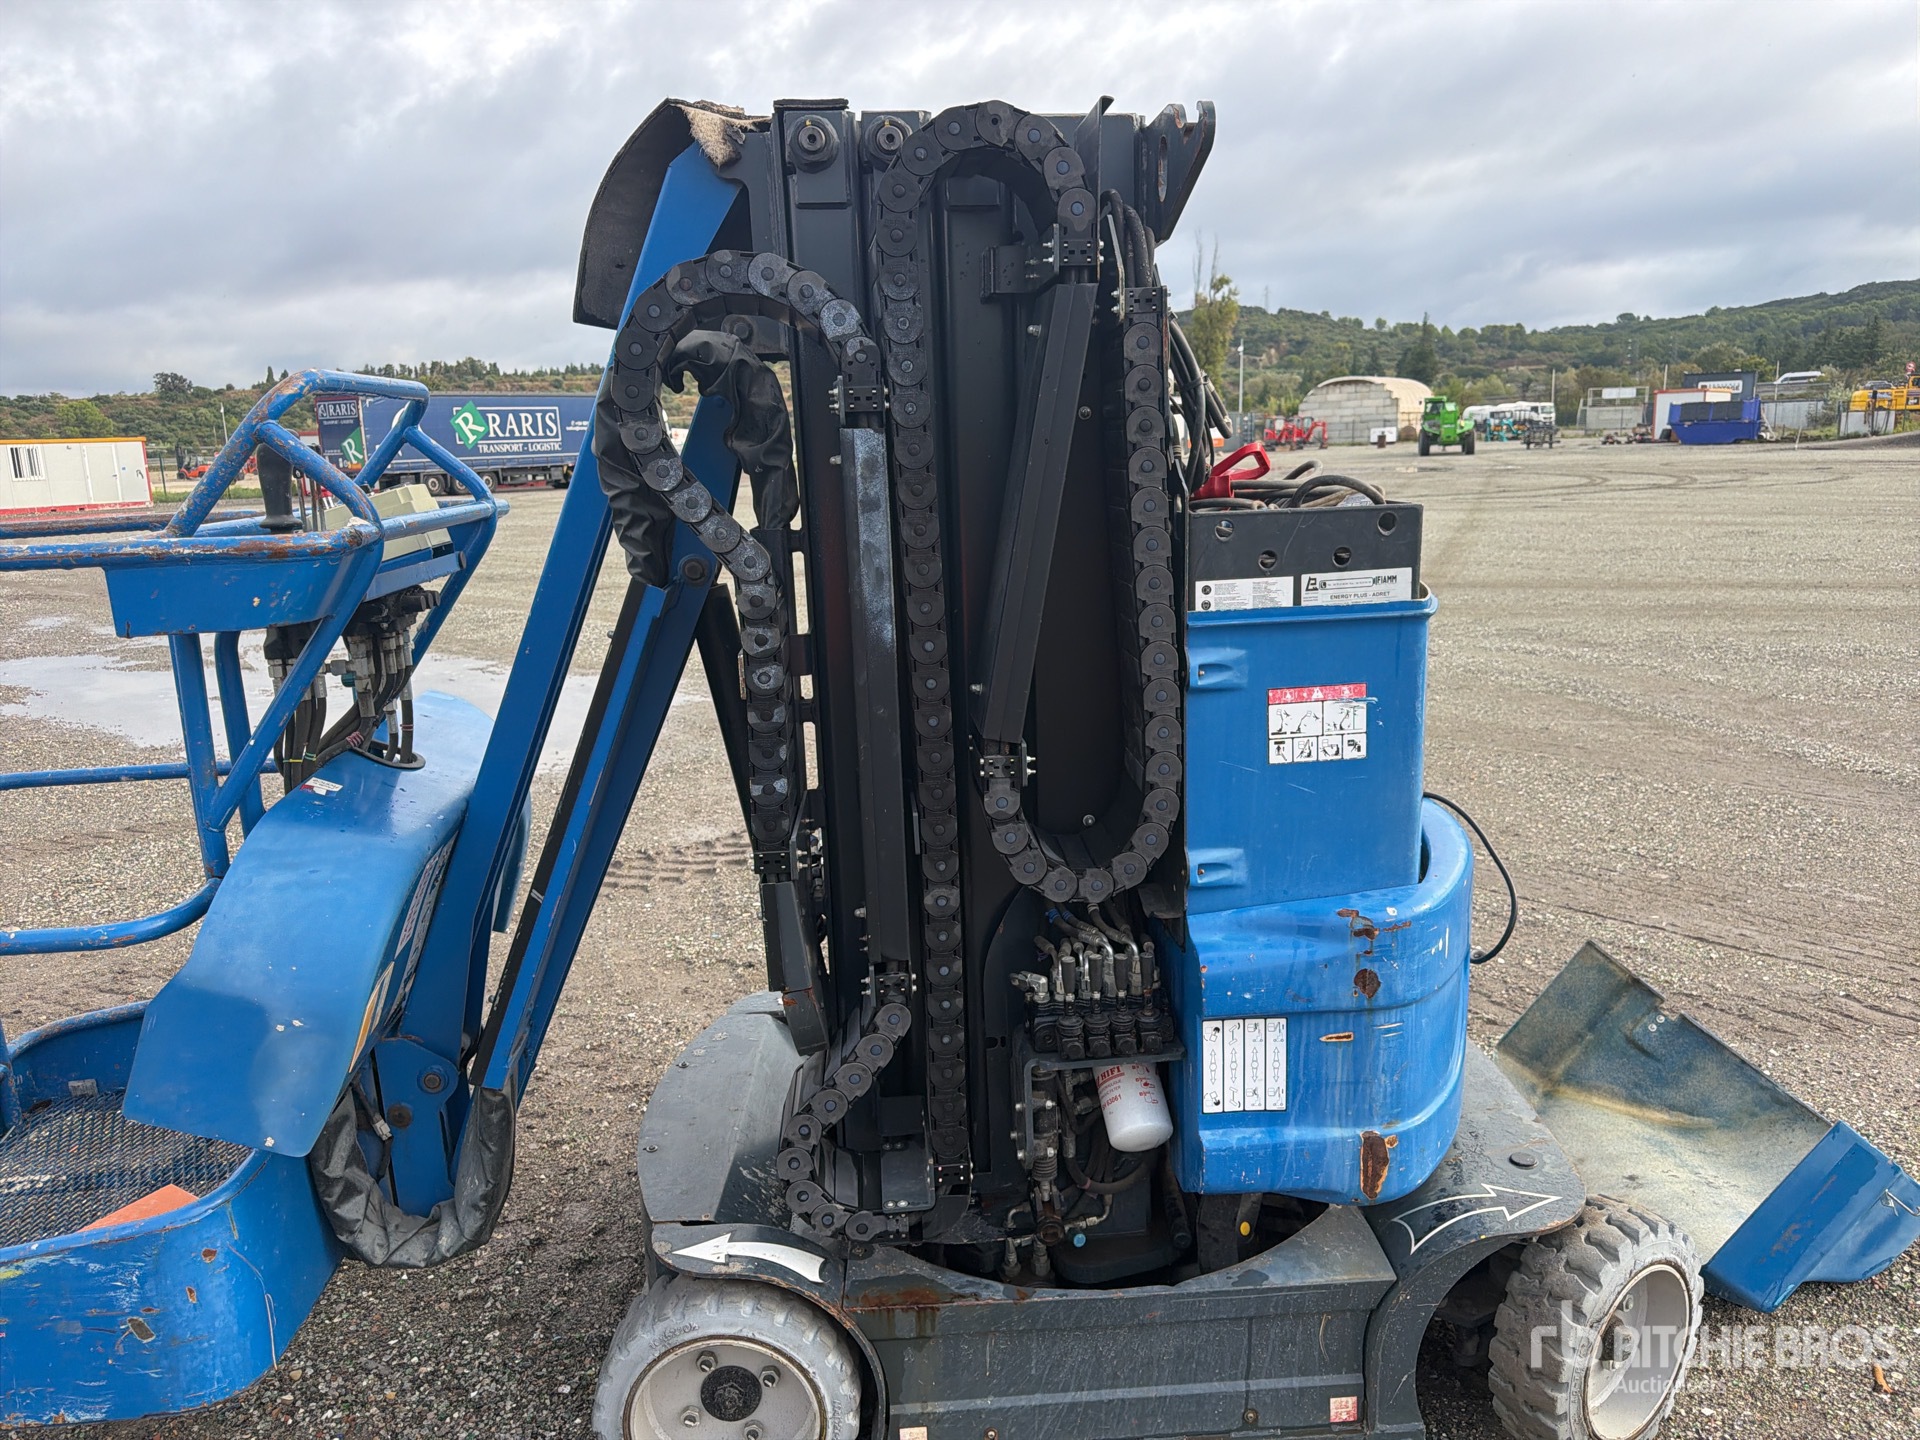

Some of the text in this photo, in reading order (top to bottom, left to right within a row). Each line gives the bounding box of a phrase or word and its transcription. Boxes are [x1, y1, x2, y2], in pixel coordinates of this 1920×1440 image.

[328, 403, 356, 416] RARIS
[454, 412, 557, 444] R RARIS
[342, 438, 363, 464] R
[477, 443, 523, 453] TRANSPORT
[528, 442, 562, 451] LOGISTIC
[1377, 575, 1397, 585] FIAMM
[1100, 1065, 1121, 1080] HIFI
